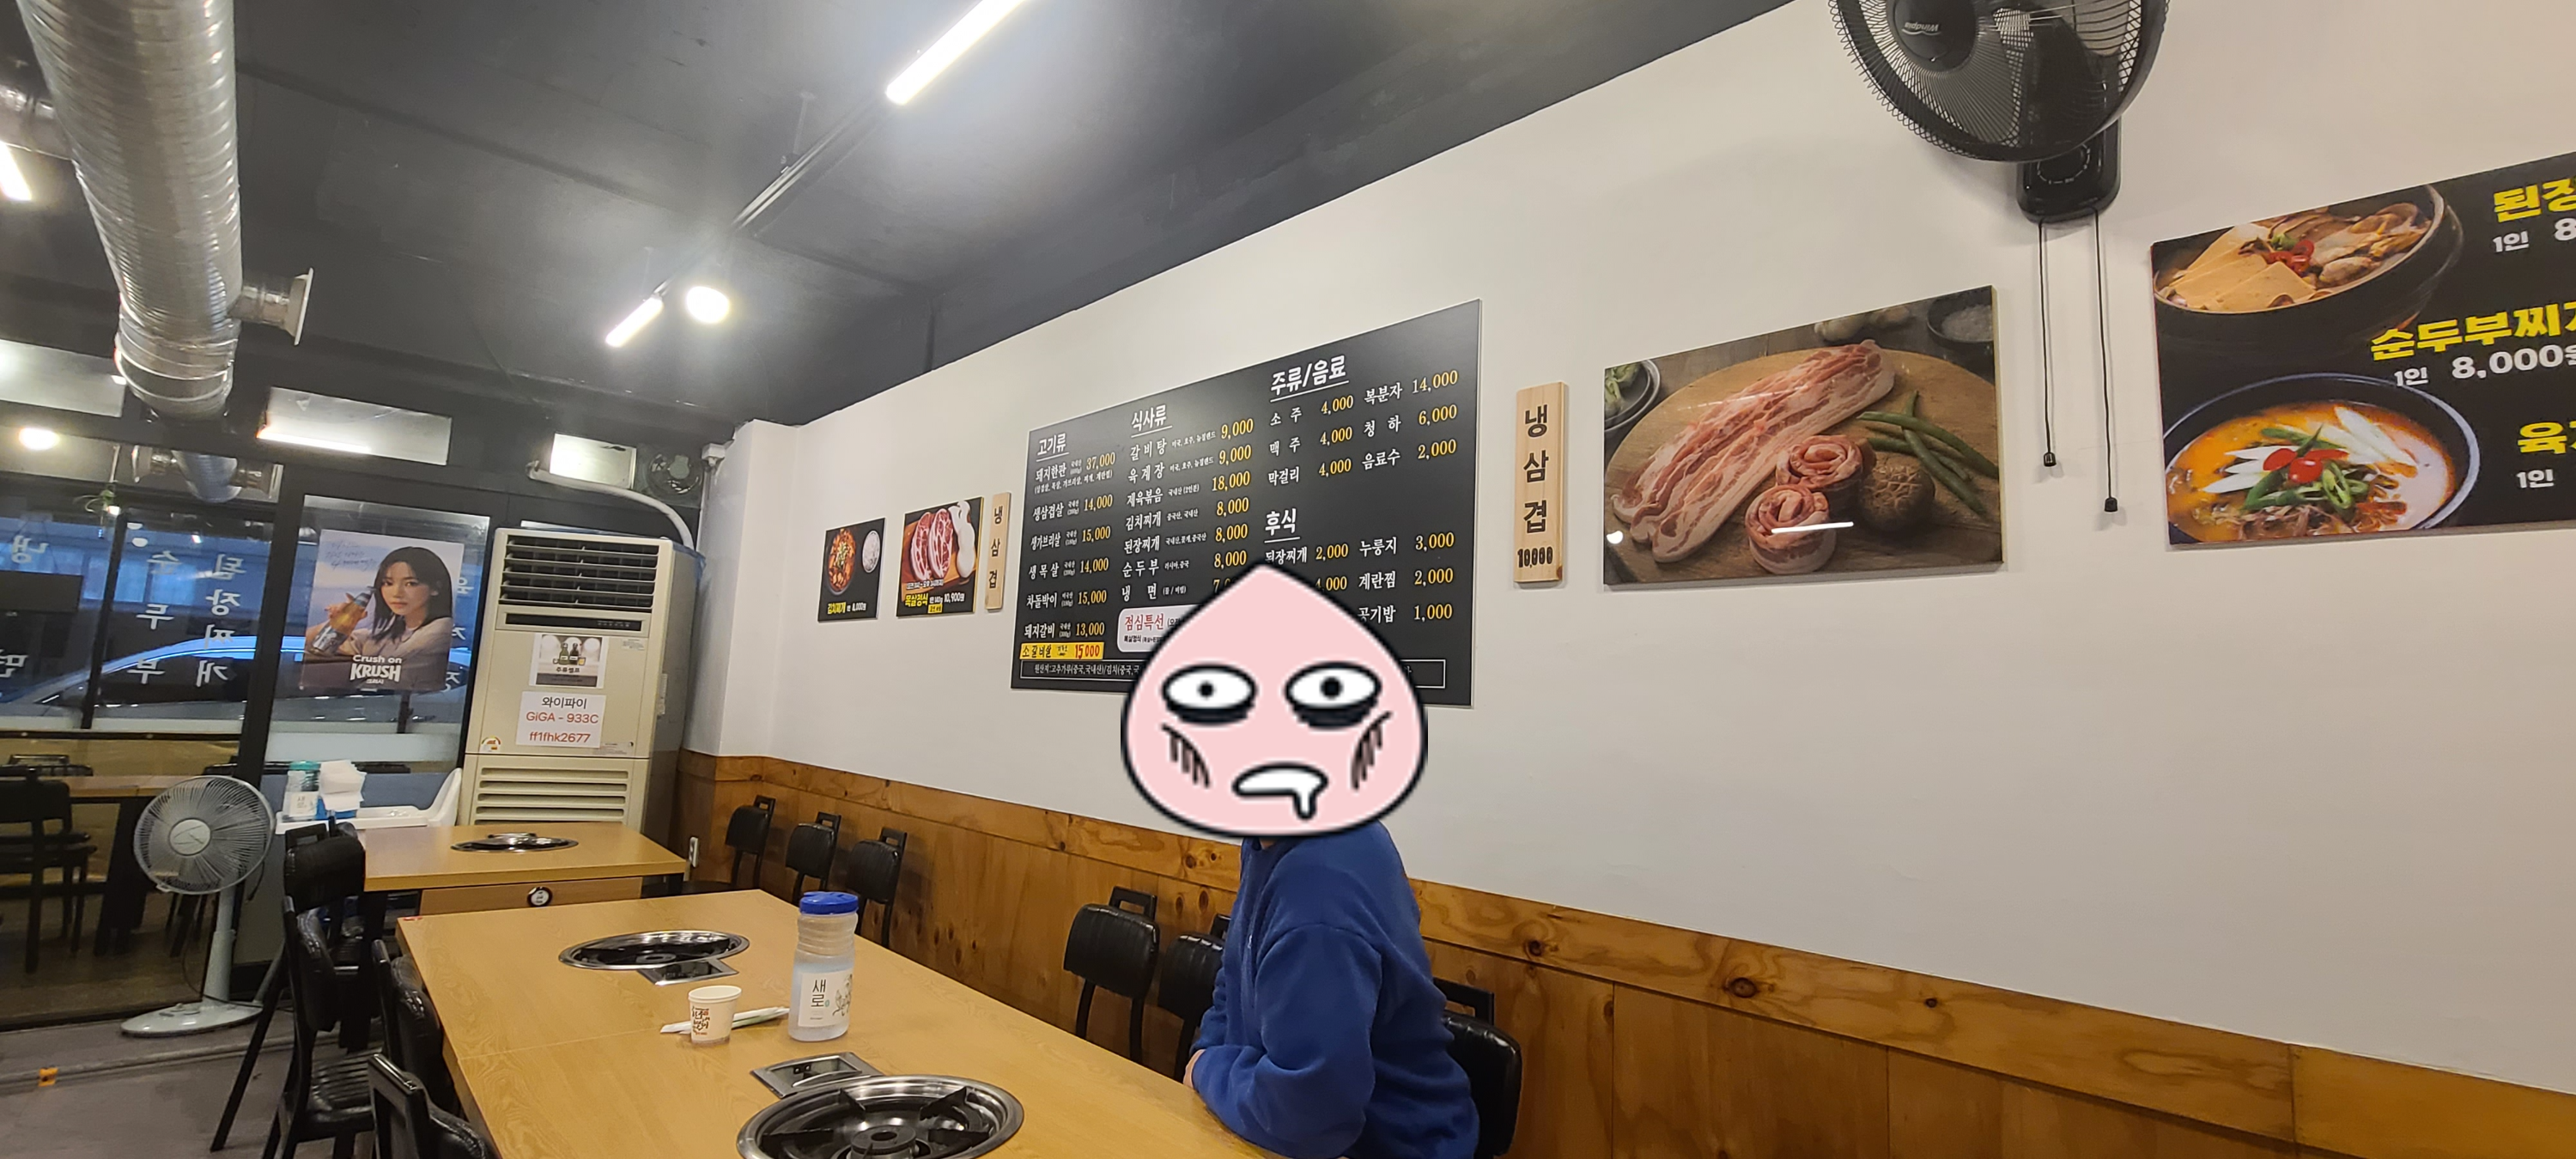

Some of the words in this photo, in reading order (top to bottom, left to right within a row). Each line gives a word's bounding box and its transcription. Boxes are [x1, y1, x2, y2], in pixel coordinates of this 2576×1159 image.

[2493, 230, 2529, 252] 1인
[1271, 355, 1346, 396] 주류/음료
[2394, 367, 2429, 386] 1인
[1321, 395, 1353, 415] 4,000
[1364, 382, 1402, 405] 복분자
[1413, 370, 1458, 394] 14,000
[1132, 404, 1167, 431] 식사류
[1320, 427, 1352, 446] 4,000
[1418, 404, 1457, 427] 6,000
[1221, 418, 1254, 440] 9,000
[2517, 421, 2576, 454] 육
[1037, 434, 1066, 455] 고기류
[1219, 444, 1252, 466] 9,000
[1036, 463, 1066, 482] 돼지한판
[1086, 452, 1115, 470] 37,000
[1268, 467, 1300, 486] 막걸리
[1319, 458, 1352, 477] 4,000
[1362, 449, 1400, 470] 음료수
[1418, 439, 1457, 460] 2,000
[1127, 487, 1163, 507] 제육볶음
[1212, 470, 1250, 491] 18,000
[2517, 469, 2555, 488] 1인
[1033, 502, 1064, 521] 생삼겹살
[1084, 495, 1113, 512] 14,000
[1126, 511, 1161, 531] 김치찌개
[1216, 497, 1249, 517] 8,000
[1265, 507, 1297, 537] 후식
[1030, 532, 1060, 550] 생가브리살
[1082, 525, 1111, 543] 15,000
[1124, 535, 1160, 554] 된장찌개
[1215, 524, 1249, 543] 8,000
[1265, 547, 1308, 565] 된장찌개
[1315, 543, 1349, 561] 2,000
[1359, 537, 1397, 557] 누룽지
[1415, 532, 1455, 551] 3,000
[1080, 558, 1109, 574] 14,000
[1214, 550, 1247, 569] 8,000
[1358, 571, 1396, 591] 계란찜
[1414, 567, 1454, 586] 2,000
[1026, 592, 1058, 610] 차돌박이
[1078, 590, 1107, 605] 15,000
[1124, 613, 1164, 631] 점심특선
[1358, 605, 1396, 623] 공기밥
[1414, 604, 1452, 622] 1,000
[1024, 622, 1055, 639] 돼지갈비
[1076, 622, 1105, 637] 13,000
[353, 654, 385, 663] Crush
[350, 664, 401, 683] KRUSH
[542, 696, 587, 709] 와이파이
[567, 713, 598, 724] 933C
